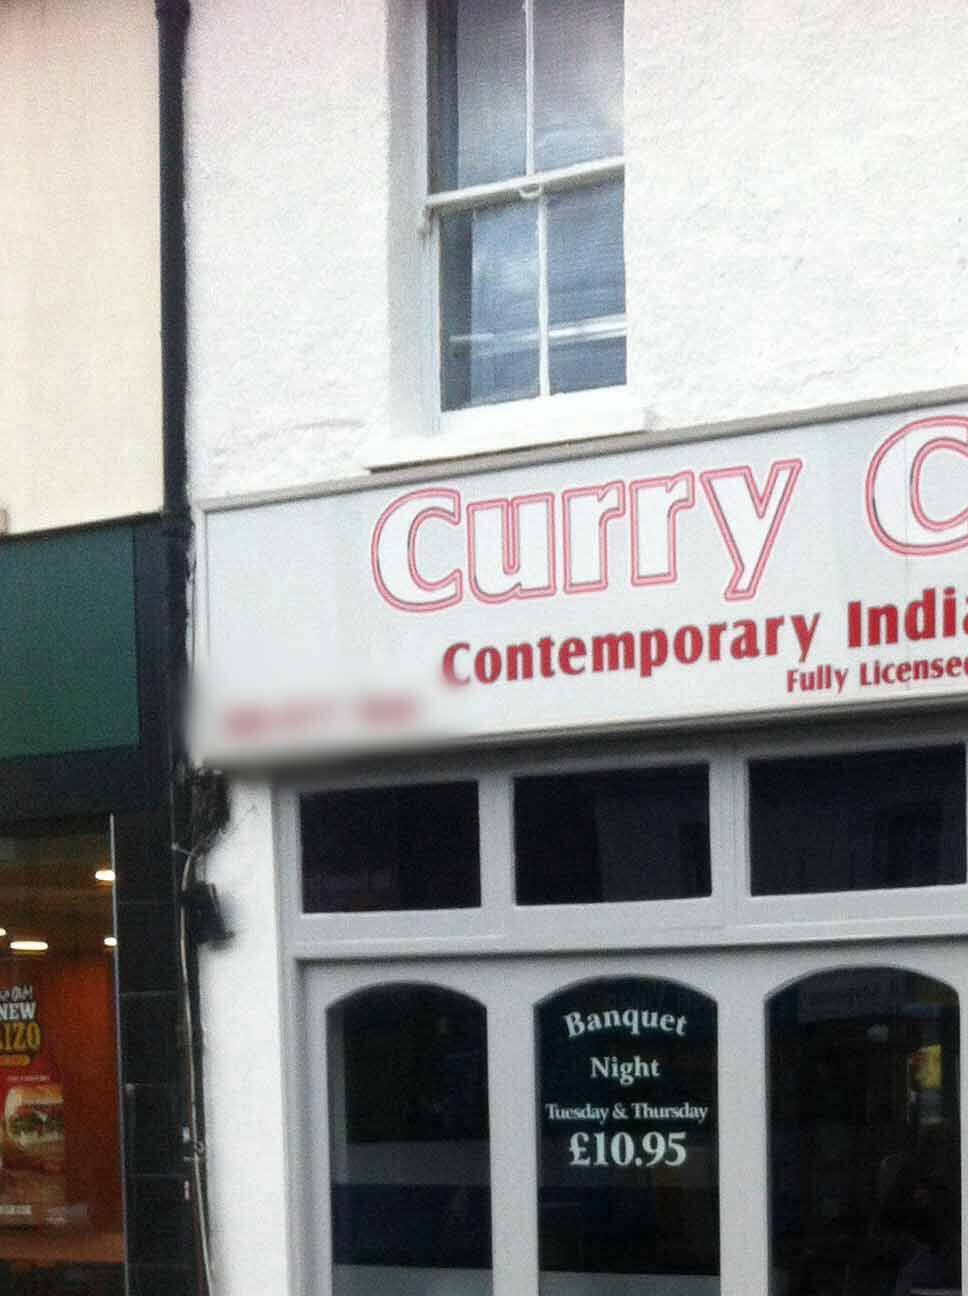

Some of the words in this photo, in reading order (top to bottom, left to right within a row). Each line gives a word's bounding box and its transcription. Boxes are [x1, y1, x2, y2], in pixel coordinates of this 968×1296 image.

[370, 458, 803, 613] Curry
[441, 612, 821, 688] Contemporary
[786, 664, 848, 693] Fully
[563, 1008, 687, 1038] Banquet
[590, 1056, 661, 1085] Night
[545, 1103, 609, 1125] Tuesday
[612, 1102, 629, 1120] &
[632, 1102, 708, 1123] Thursday
[569, 1131, 687, 1167] £10.95
